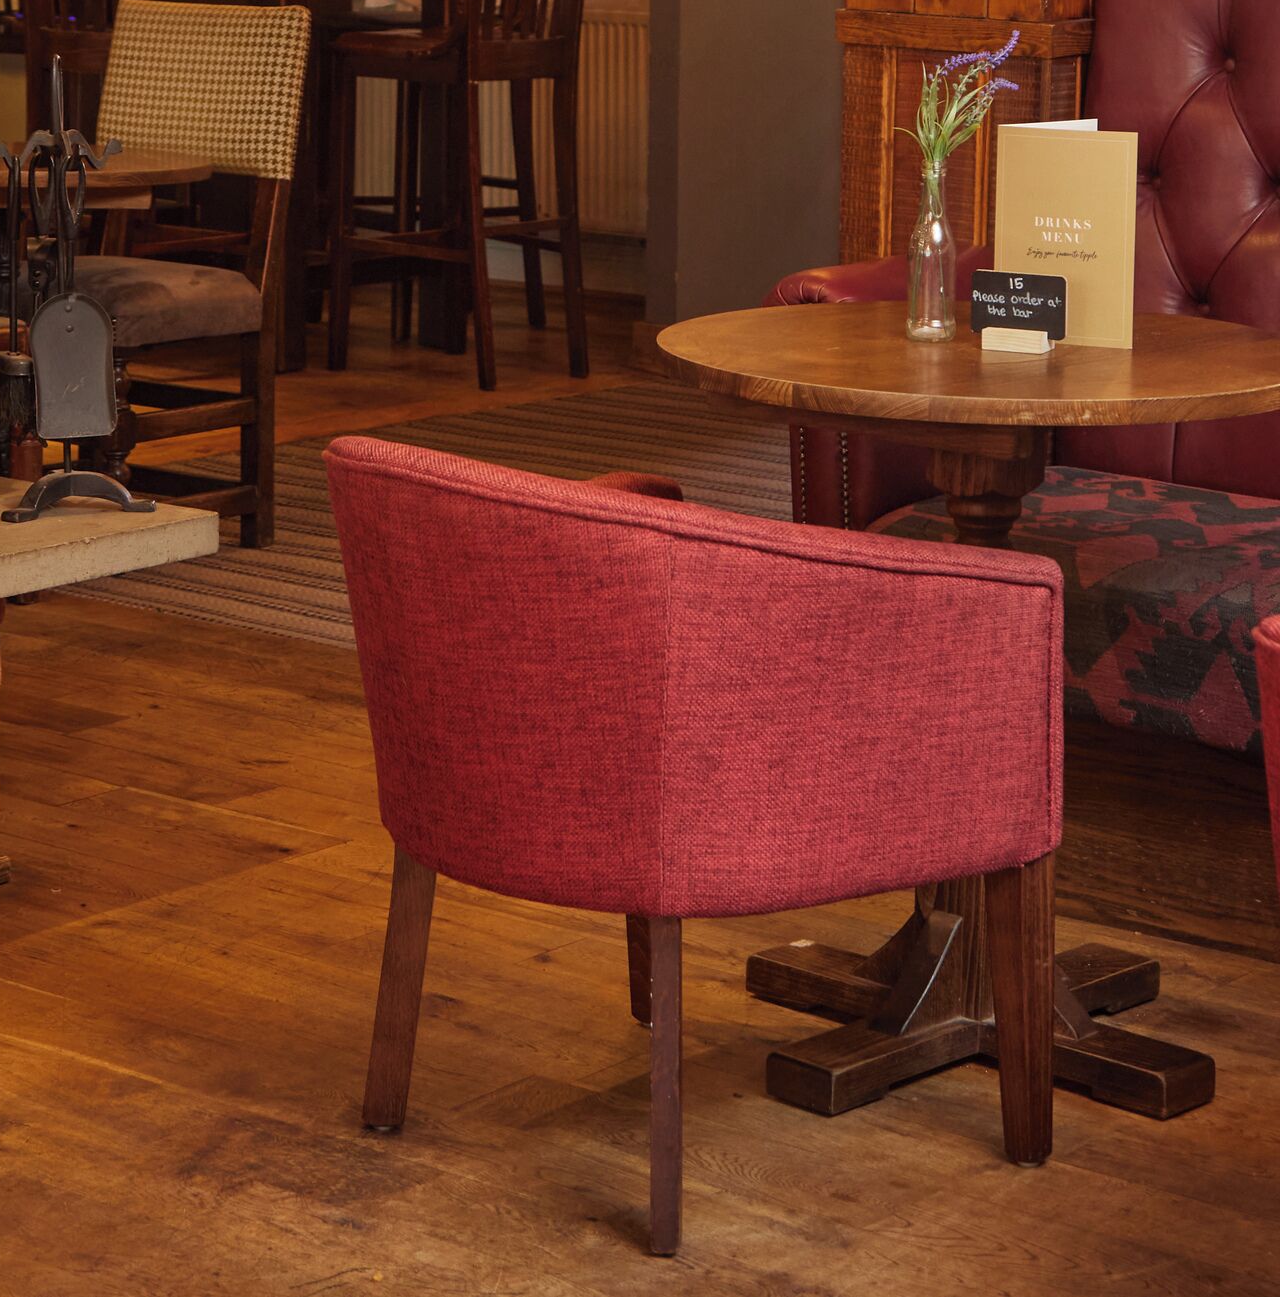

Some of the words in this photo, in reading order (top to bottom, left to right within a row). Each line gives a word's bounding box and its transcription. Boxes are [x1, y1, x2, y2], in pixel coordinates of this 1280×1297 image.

[1034, 216, 1092, 230] DRINKS
[1042, 231, 1082, 244] MENU
[1009, 277, 1024, 290] 15
[972, 290, 1006, 304] Please
[1010, 291, 1044, 306] order
[1047, 296, 1062, 308] at
[987, 304, 1007, 317] the
[1012, 306, 1033, 318] bar
